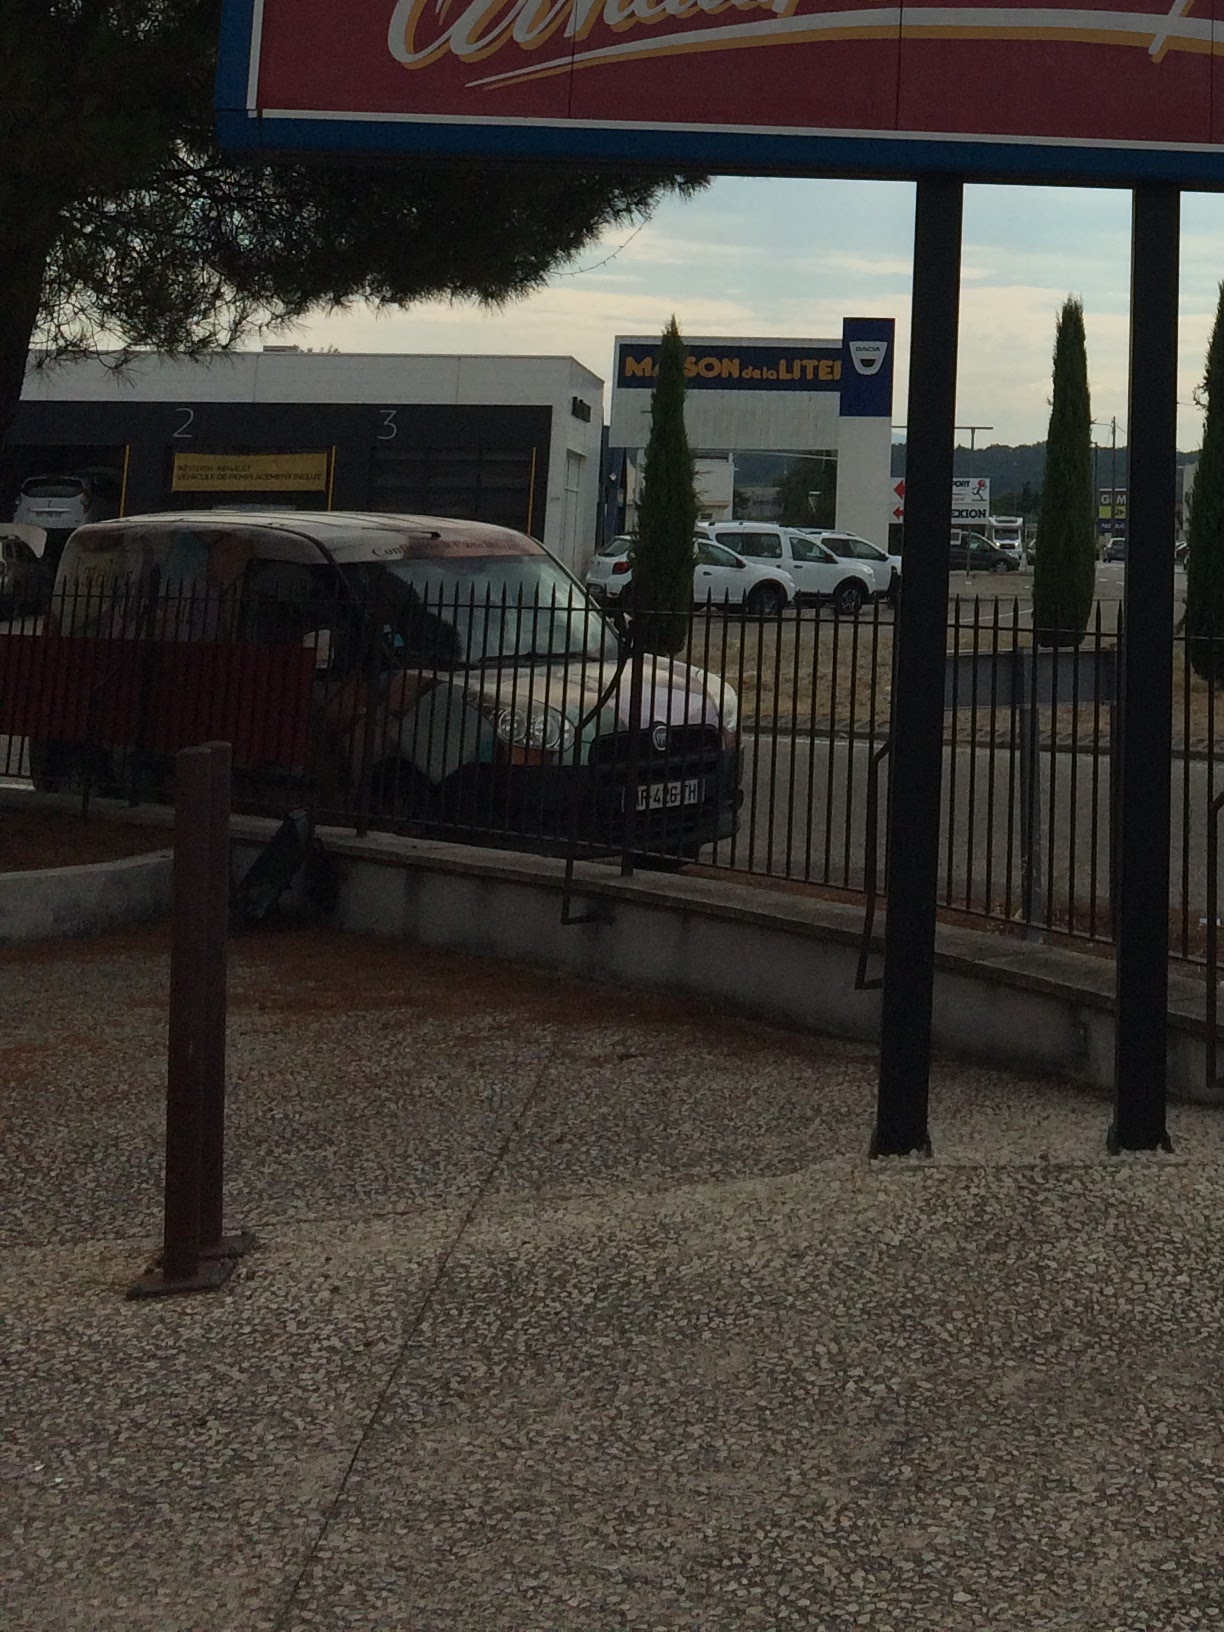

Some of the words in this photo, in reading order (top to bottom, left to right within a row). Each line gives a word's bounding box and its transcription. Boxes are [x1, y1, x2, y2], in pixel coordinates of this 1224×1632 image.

[855, 345, 881, 353] DACIA
[624, 355, 741, 379] MSON
[172, 408, 195, 439] 2
[377, 409, 398, 439] 3
